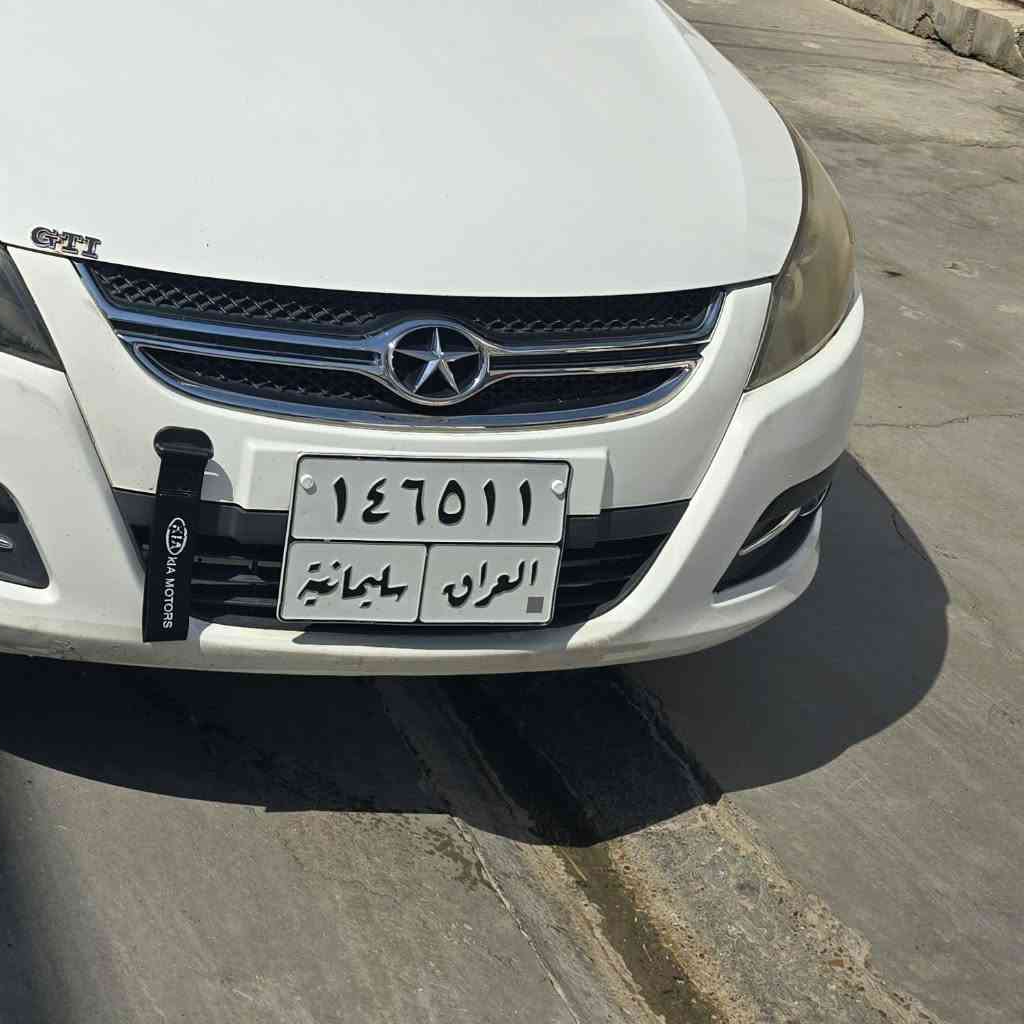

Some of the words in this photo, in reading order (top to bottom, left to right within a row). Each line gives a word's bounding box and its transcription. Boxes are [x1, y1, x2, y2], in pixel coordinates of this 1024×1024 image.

[31, 226, 102, 259] GTI
[333, 476, 531, 525] ١٤٦٥١١
[169, 523, 184, 551] KIA
[166, 556, 178, 575] KIA
[297, 560, 408, 607] سليمانية
[443, 560, 538, 607] العراق
[162, 577, 176, 629] MOTORS
